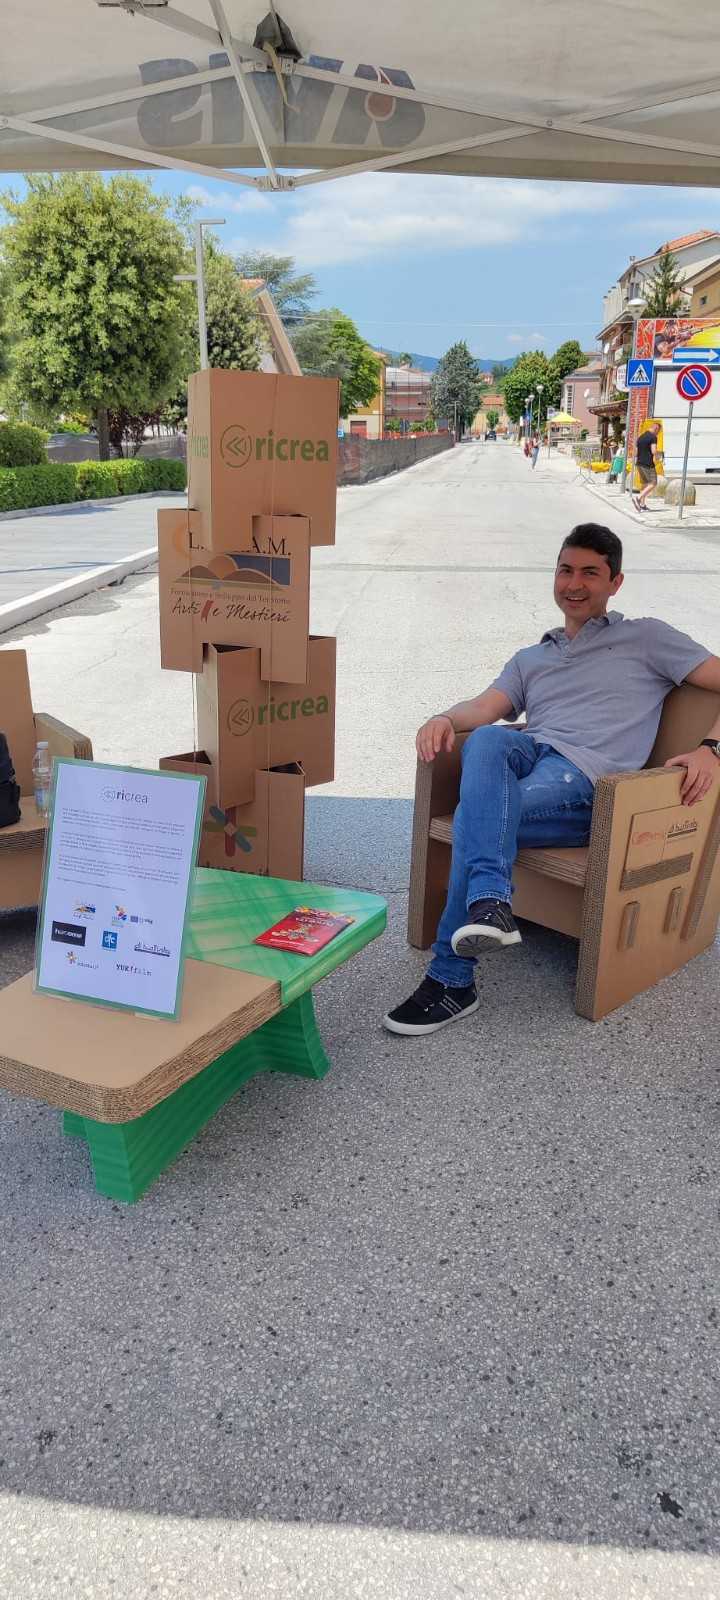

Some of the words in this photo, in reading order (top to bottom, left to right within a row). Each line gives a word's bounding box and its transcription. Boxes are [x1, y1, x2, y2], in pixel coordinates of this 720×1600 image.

[255, 431, 329, 462] ricrea
[226, 603, 290, 622] Mestieri
[257, 695, 329, 725] ricrea
[116, 789, 149, 804] ricrea
